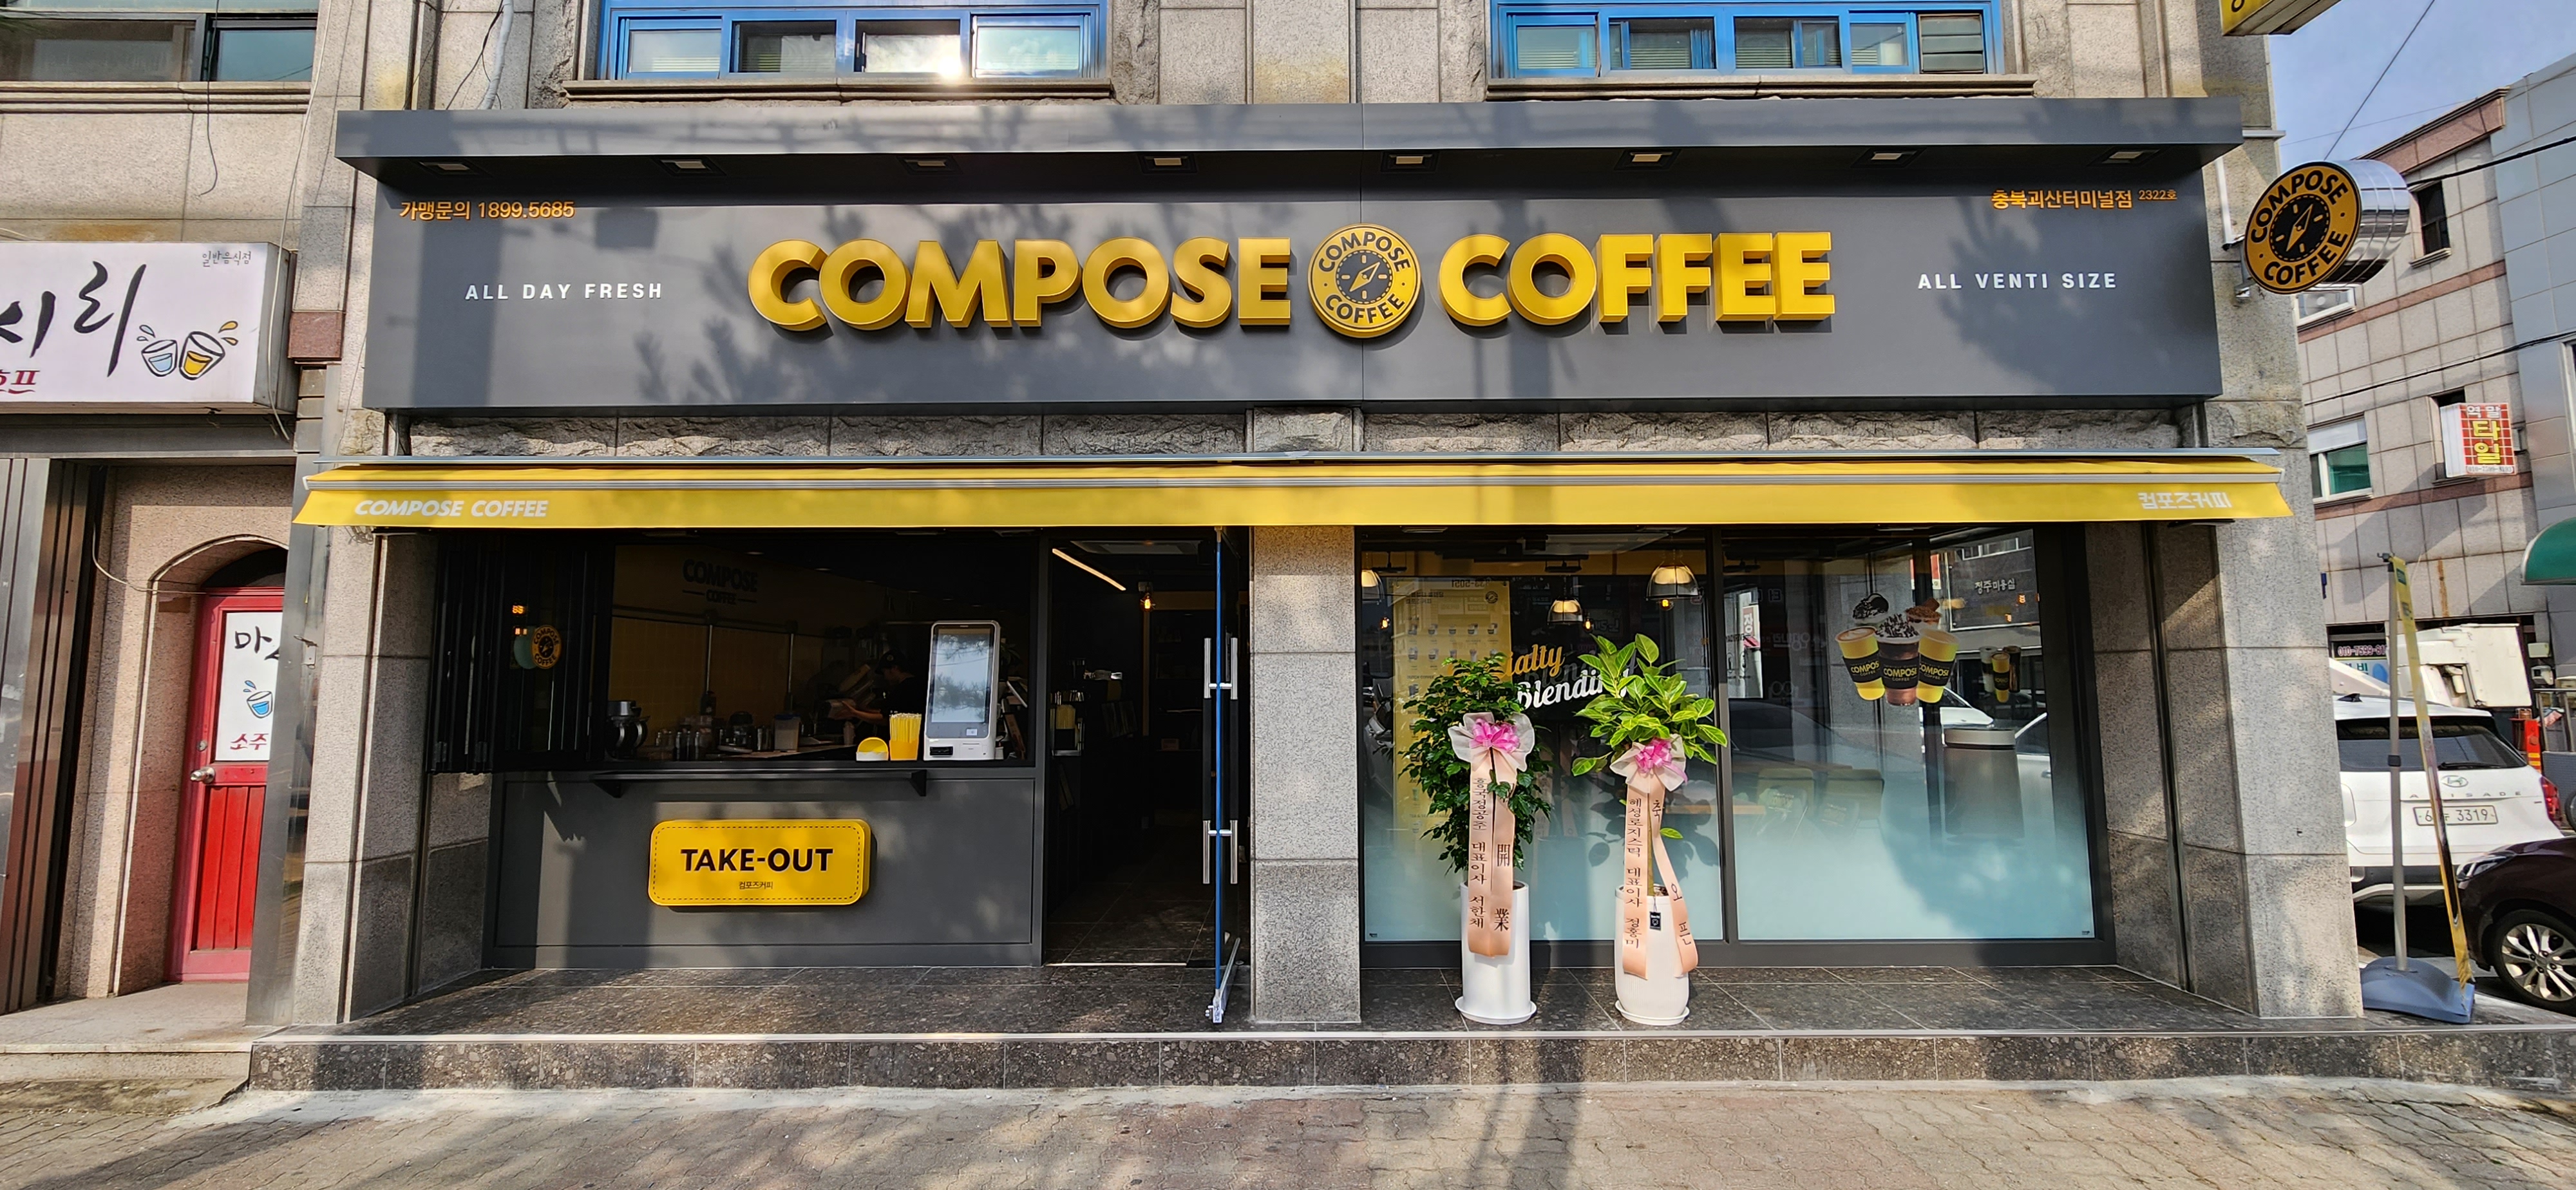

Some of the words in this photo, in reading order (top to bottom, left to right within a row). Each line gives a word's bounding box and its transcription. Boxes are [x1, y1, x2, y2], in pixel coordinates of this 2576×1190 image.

[1991, 190, 2132, 209] 충북괴산터미널점
[2138, 189, 2177, 201] 2322호
[2251, 169, 2348, 243] COMPOSE
[399, 202, 471, 220] 가맹문의
[478, 202, 575, 219] 1899.5685
[202, 250, 252, 267] 일반음식점
[1319, 232, 1411, 272] COMPOSE
[2264, 231, 2347, 284] COFFEE
[748, 236, 1291, 330] COMPOSE
[1439, 232, 1835, 326] COFFEE
[1918, 274, 1962, 289] ALL
[1975, 274, 2048, 289] VENTI
[2062, 273, 2117, 288] SIZE
[465, 285, 509, 300] ALL
[523, 284, 571, 299] DAY
[585, 283, 662, 299] FRESH
[1326, 294, 1405, 323] COFFEE
[2467, 406, 2501, 418] 역말
[2472, 420, 2501, 464] 타일
[355, 500, 464, 516] COMPOSE
[471, 500, 549, 517] COFFEE
[2138, 492, 2233, 509] 컴포즈커피
[683, 559, 758, 592] COMPOSE
[534, 628, 559, 645] COMPOSE
[535, 654, 556, 665] COFFEE
[2338, 645, 2387, 656] 010-7599-81
[1850, 661, 1880, 674] COMPOS
[1883, 667, 1918, 677] COMPOSE
[230, 733, 269, 750] 소주
[1652, 800, 1661, 822] 축
[2456, 809, 2488, 821] 3319
[680, 847, 833, 872] TAKE-OUT
[1470, 842, 1487, 885] 대표이사
[739, 881, 773, 890] 컴포즈커피
[1625, 867, 1642, 907] 대표이사
[1469, 895, 1486, 929] 서한채
